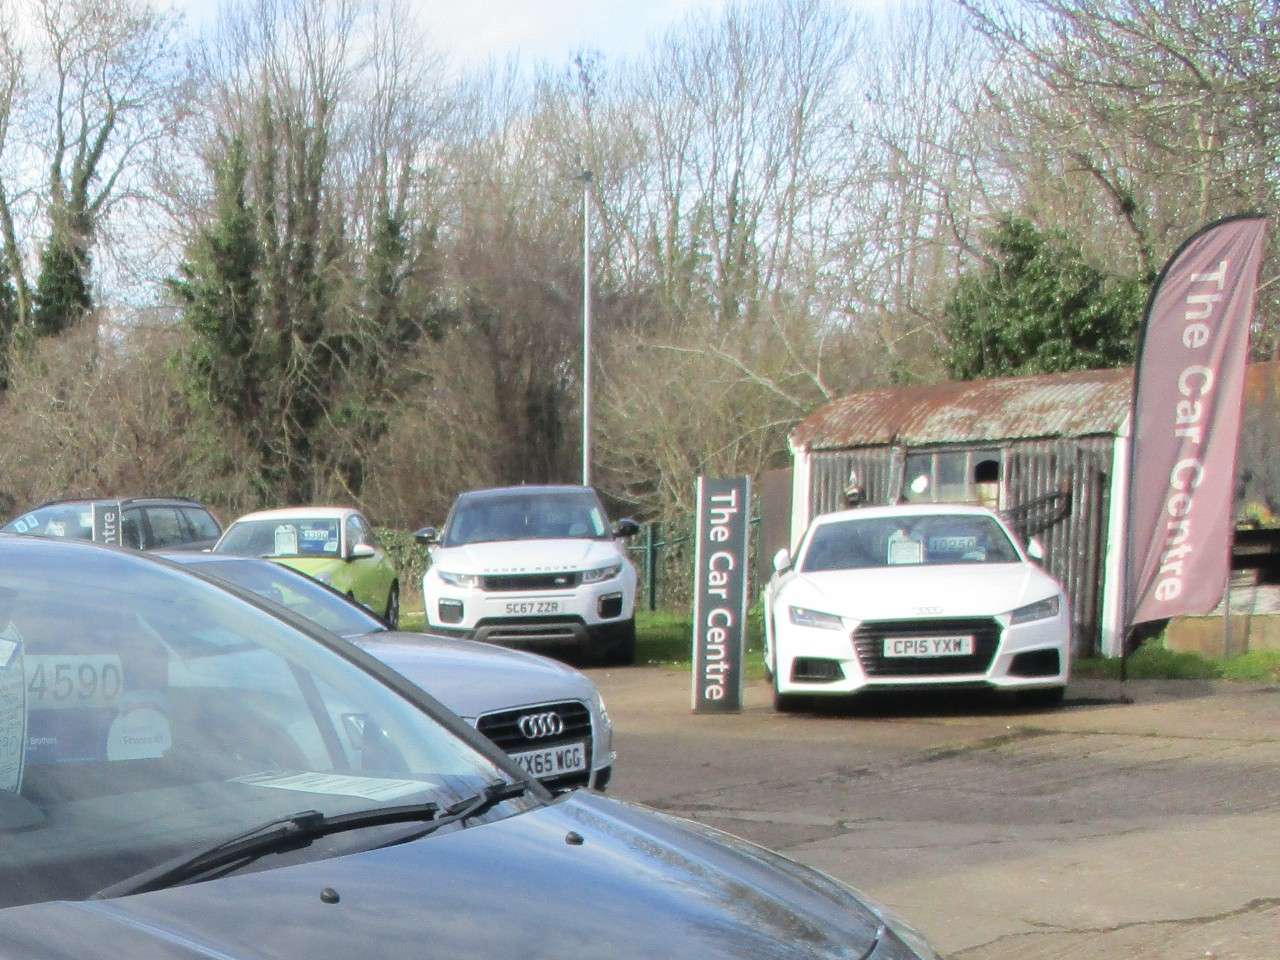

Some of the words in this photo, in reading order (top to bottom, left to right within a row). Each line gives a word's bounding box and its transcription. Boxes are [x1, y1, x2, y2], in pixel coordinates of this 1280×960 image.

[1182, 260, 1228, 349] The
[1175, 365, 1215, 444] Car
[710, 489, 737, 542] The
[1154, 456, 1206, 602] Centre
[708, 552, 734, 599] Car
[505, 602, 534, 614] SC67
[536, 601, 559, 613] ZZR
[705, 608, 732, 700] Centre
[893, 640, 928, 654] CP15
[27, 663, 121, 701] 4590
